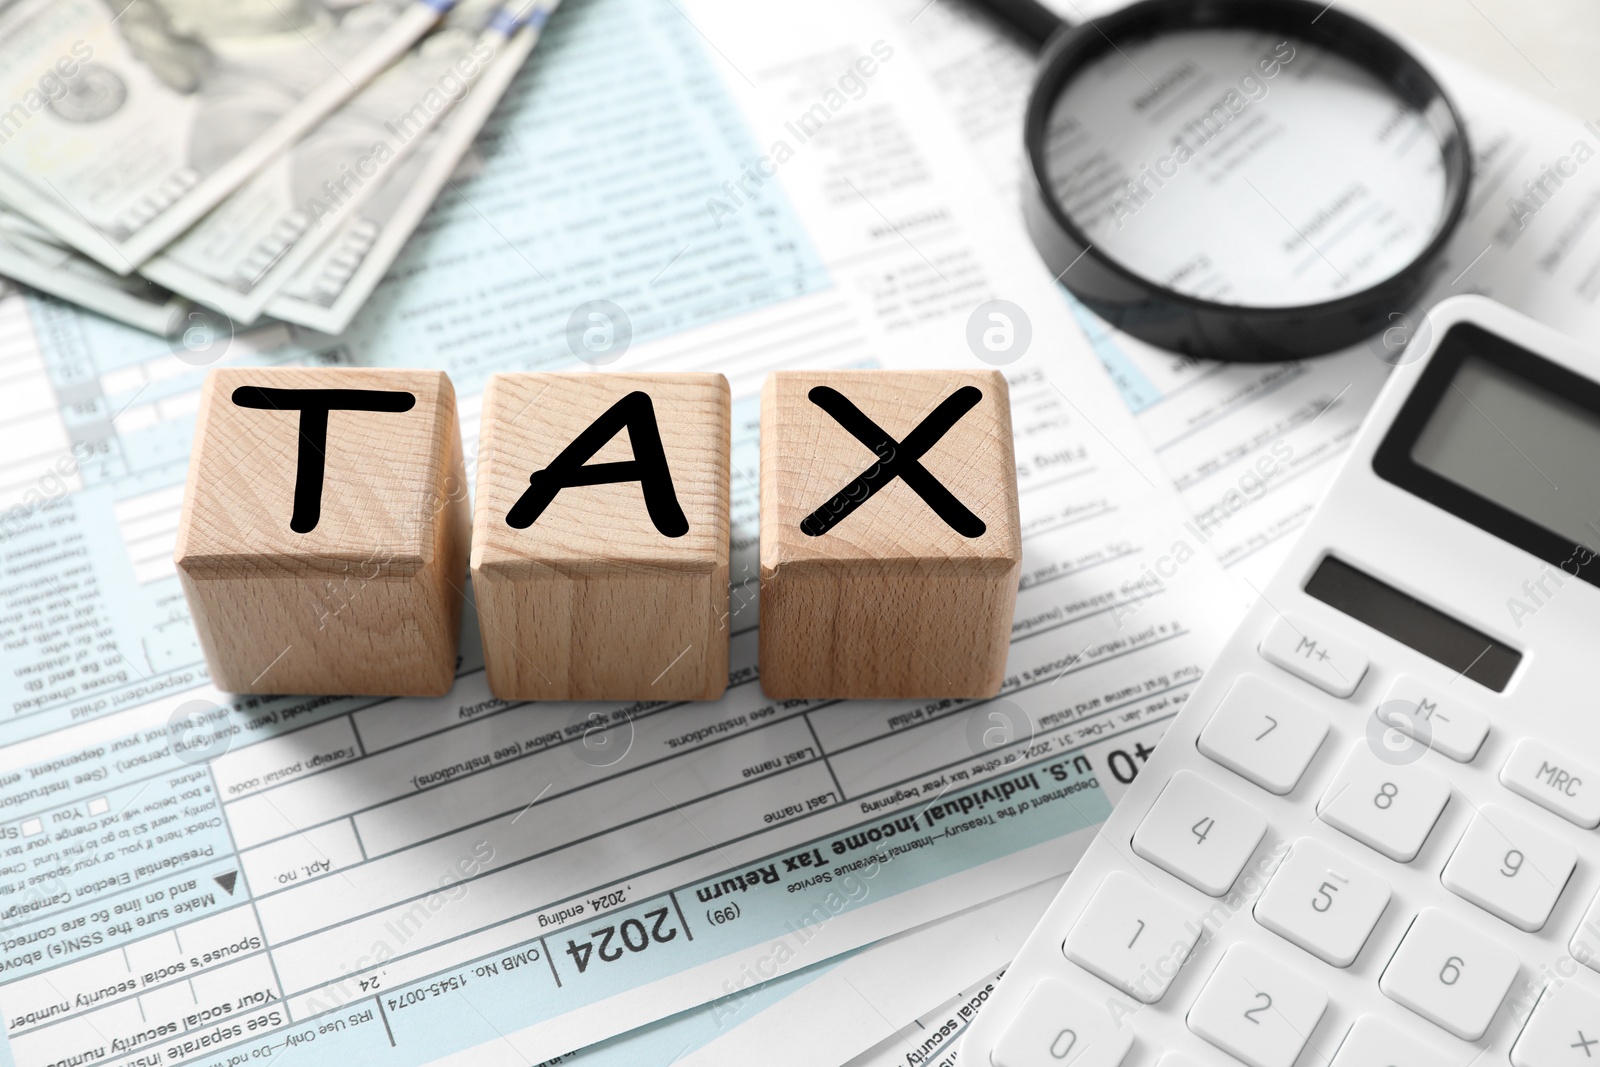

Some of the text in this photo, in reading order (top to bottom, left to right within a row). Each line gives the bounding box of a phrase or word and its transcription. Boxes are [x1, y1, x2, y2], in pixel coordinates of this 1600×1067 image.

[1294, 636, 1331, 663] M+
[748, 704, 775, 721] see
[887, 697, 952, 729] and initial
[1074, 697, 1100, 716] and
[1414, 698, 1451, 723] M-
[1037, 708, 1073, 729] initial
[1254, 715, 1278, 742] 7
[524, 729, 564, 750] below
[663, 715, 747, 748] instructions.
[741, 746, 816, 778] Last name
[971, 758, 1002, 776] other
[1003, 753, 1016, 764] or
[228, 746, 355, 794] Foreign postal code
[948, 769, 970, 782] tax
[1535, 760, 1583, 798] MRC
[921, 774, 948, 793] year
[1029, 776, 1099, 808] Department
[763, 791, 838, 823] Last name
[859, 786, 920, 814] beginning
[1373, 782, 1399, 810] 8
[51, 807, 84, 823] You
[995, 805, 1017, 819] the
[1016, 801, 1030, 814] of
[54, 821, 98, 841] change
[150, 813, 178, 830] want
[183, 816, 222, 835] Check
[695, 754, 1092, 903] U.S. Individual Income Tax Return
[1191, 816, 1216, 845] 4
[25, 833, 52, 851] your
[85, 839, 98, 849] to
[99, 830, 116, 844] go
[117, 828, 130, 838] to
[154, 829, 183, 844] here
[73, 852, 101, 872] your
[102, 850, 115, 862] or
[1500, 849, 1525, 878] 9
[0, 844, 214, 920] Presidential Election Campaign
[27, 864, 72, 885] spouse
[273, 858, 330, 884] Apt. no.
[786, 871, 832, 893] Service
[144, 890, 165, 904] on
[168, 879, 197, 900] and
[1311, 881, 1339, 913] 5
[113, 898, 142, 915] line
[173, 892, 216, 914] Make
[537, 889, 626, 927] 2024, ending
[705, 900, 740, 926] (99)
[60, 916, 86, 932] are
[89, 908, 110, 923] 6c
[135, 907, 169, 927] sure
[106, 920, 133, 936] the
[1127, 919, 1146, 950] 1
[46, 930, 103, 959] SSN(s)
[565, 906, 677, 973] 2024
[386, 948, 540, 1011] OMB No. 1545-0074
[1439, 956, 1465, 986] 6
[8, 936, 261, 1029] Spouse's social security number
[358, 974, 380, 992] 24
[956, 983, 994, 1020] social
[1243, 992, 1273, 1025] 2
[110, 988, 277, 1053] Your social security
[246, 1010, 282, 1031] See
[317, 1018, 346, 1034] Use
[347, 1008, 374, 1026] IRS
[166, 1024, 242, 1059] separate
[905, 1018, 957, 1066] security
[1049, 1028, 1077, 1059] 0
